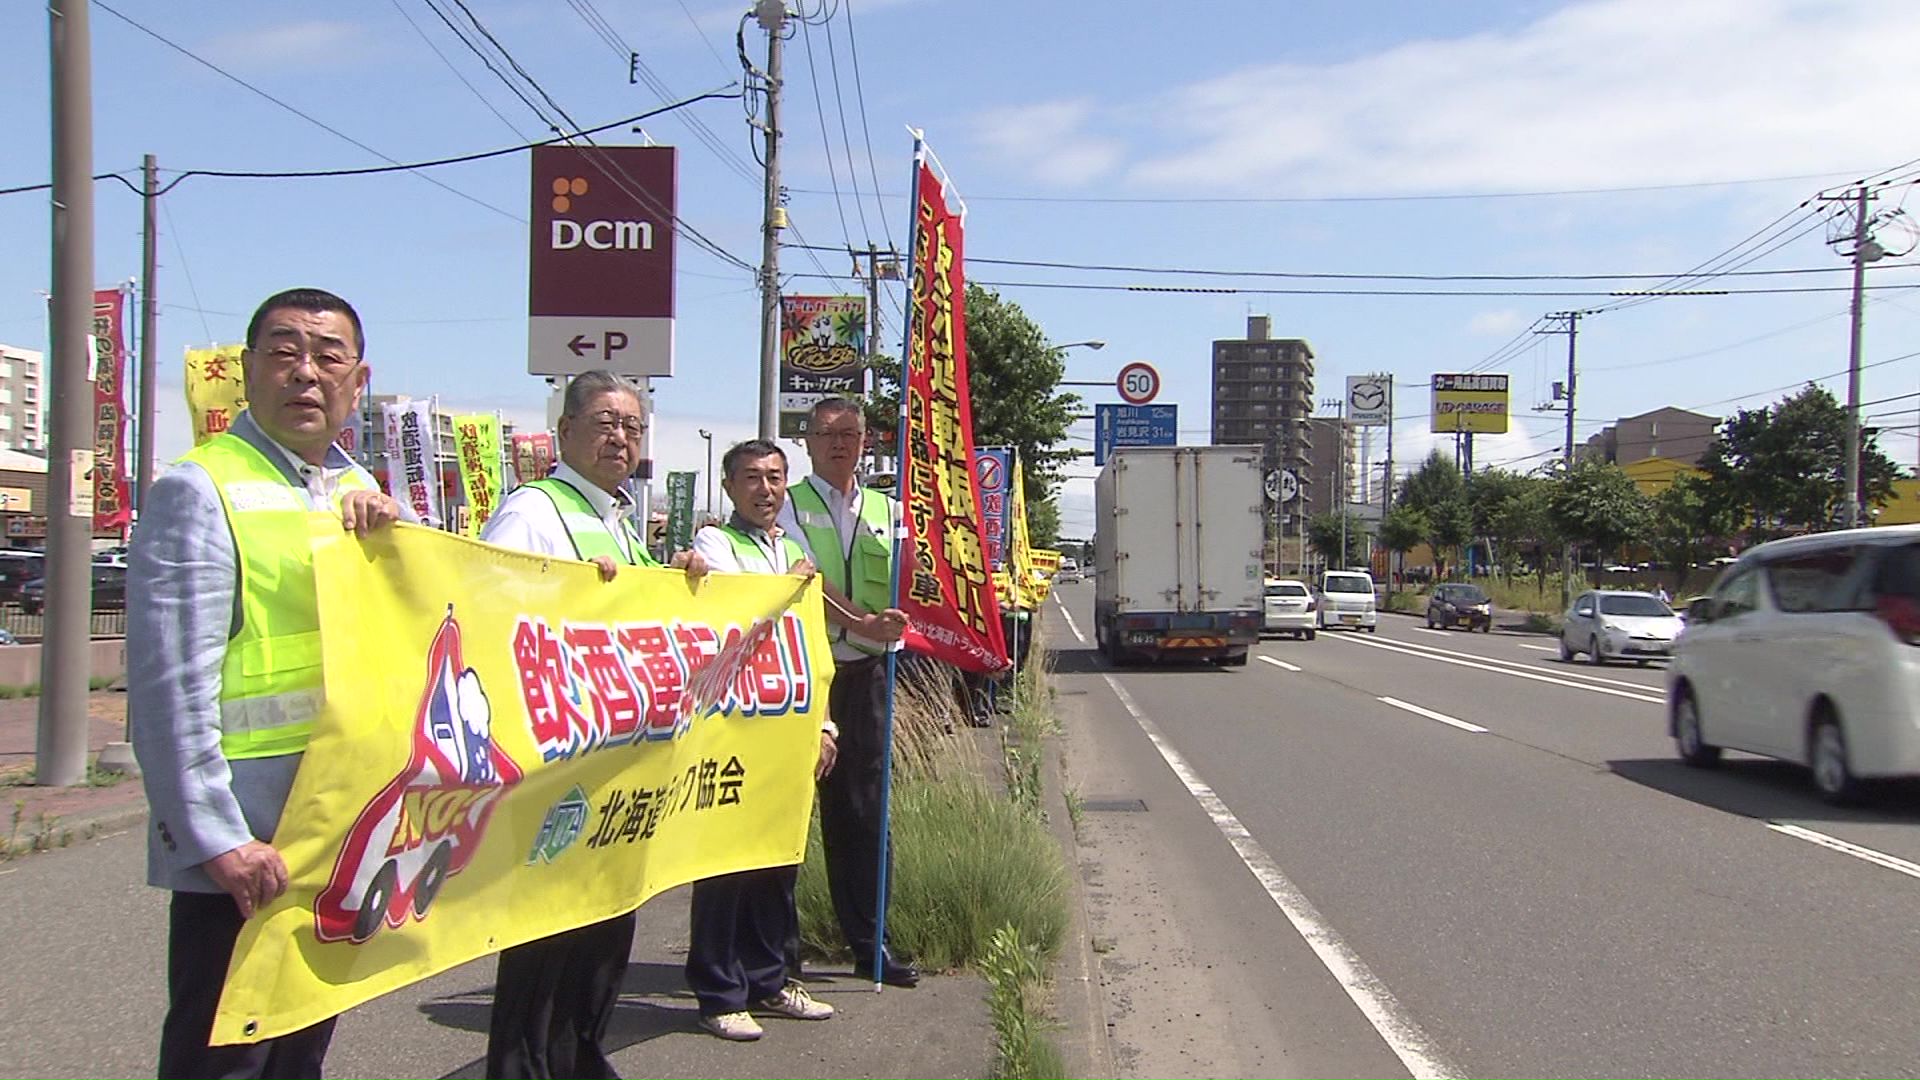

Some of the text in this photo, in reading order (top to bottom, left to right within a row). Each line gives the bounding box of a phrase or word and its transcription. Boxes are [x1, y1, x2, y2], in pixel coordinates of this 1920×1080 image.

[603, 331, 628, 360] P
[789, 375, 854, 391] キャッツアイ
[1126, 374, 1150, 393] 50
[1116, 407, 1138, 418] 旭川
[1116, 426, 1150, 438] 岩見沢
[388, 786, 502, 853] NO!
